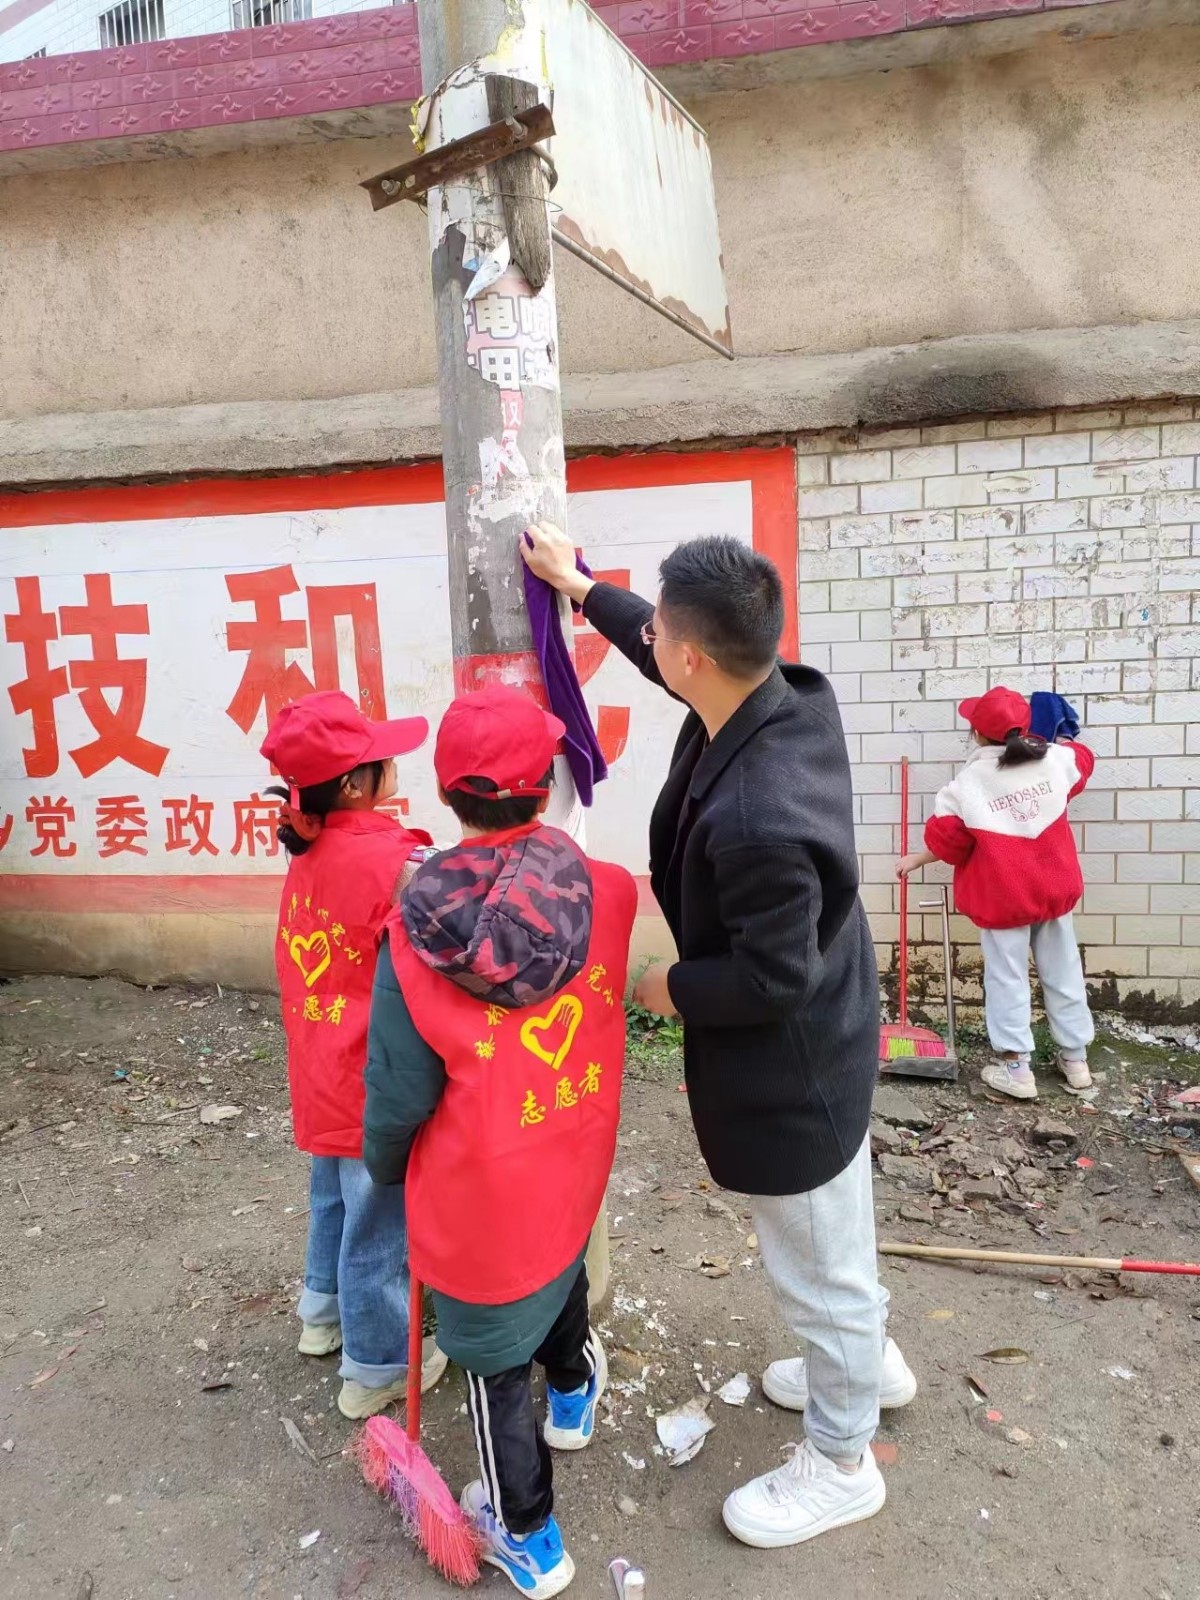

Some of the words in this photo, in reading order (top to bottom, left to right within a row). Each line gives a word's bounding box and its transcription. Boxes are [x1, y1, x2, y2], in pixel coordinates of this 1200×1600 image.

[0, 793, 409, 857] 党委政府
[292, 994, 347, 1026] 愿者
[520, 1062, 603, 1128] 志愿者
